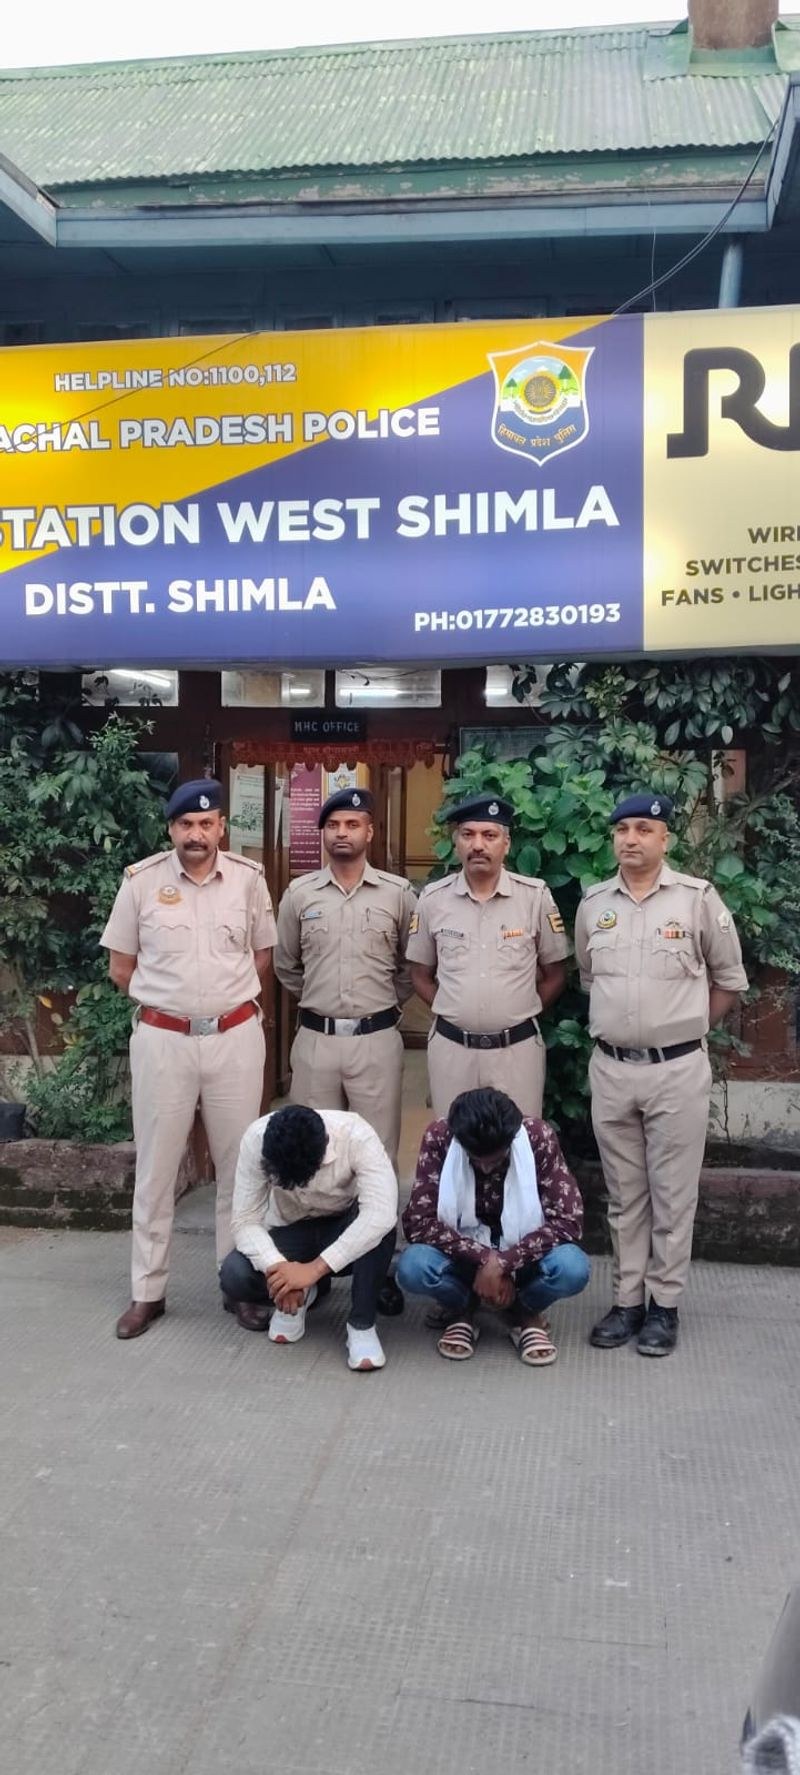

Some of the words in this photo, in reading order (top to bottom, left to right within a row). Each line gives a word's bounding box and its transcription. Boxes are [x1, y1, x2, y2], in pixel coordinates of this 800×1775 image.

[55, 369, 163, 392] HELPLINE
[169, 364, 296, 387] NO:1100,112
[667, 342, 800, 459] R
[119, 413, 294, 449] PRADESH
[304, 407, 440, 442] POLICE
[0, 503, 199, 550] TATION
[217, 498, 380, 543] WEST
[397, 485, 620, 538] SHIMLA
[25, 580, 155, 615] DISTT.
[168, 577, 337, 613] SHIMLA
[661, 587, 724, 606] FANS
[414, 603, 621, 631] PH:01772830193
[322, 721, 360, 733] OFFICE
